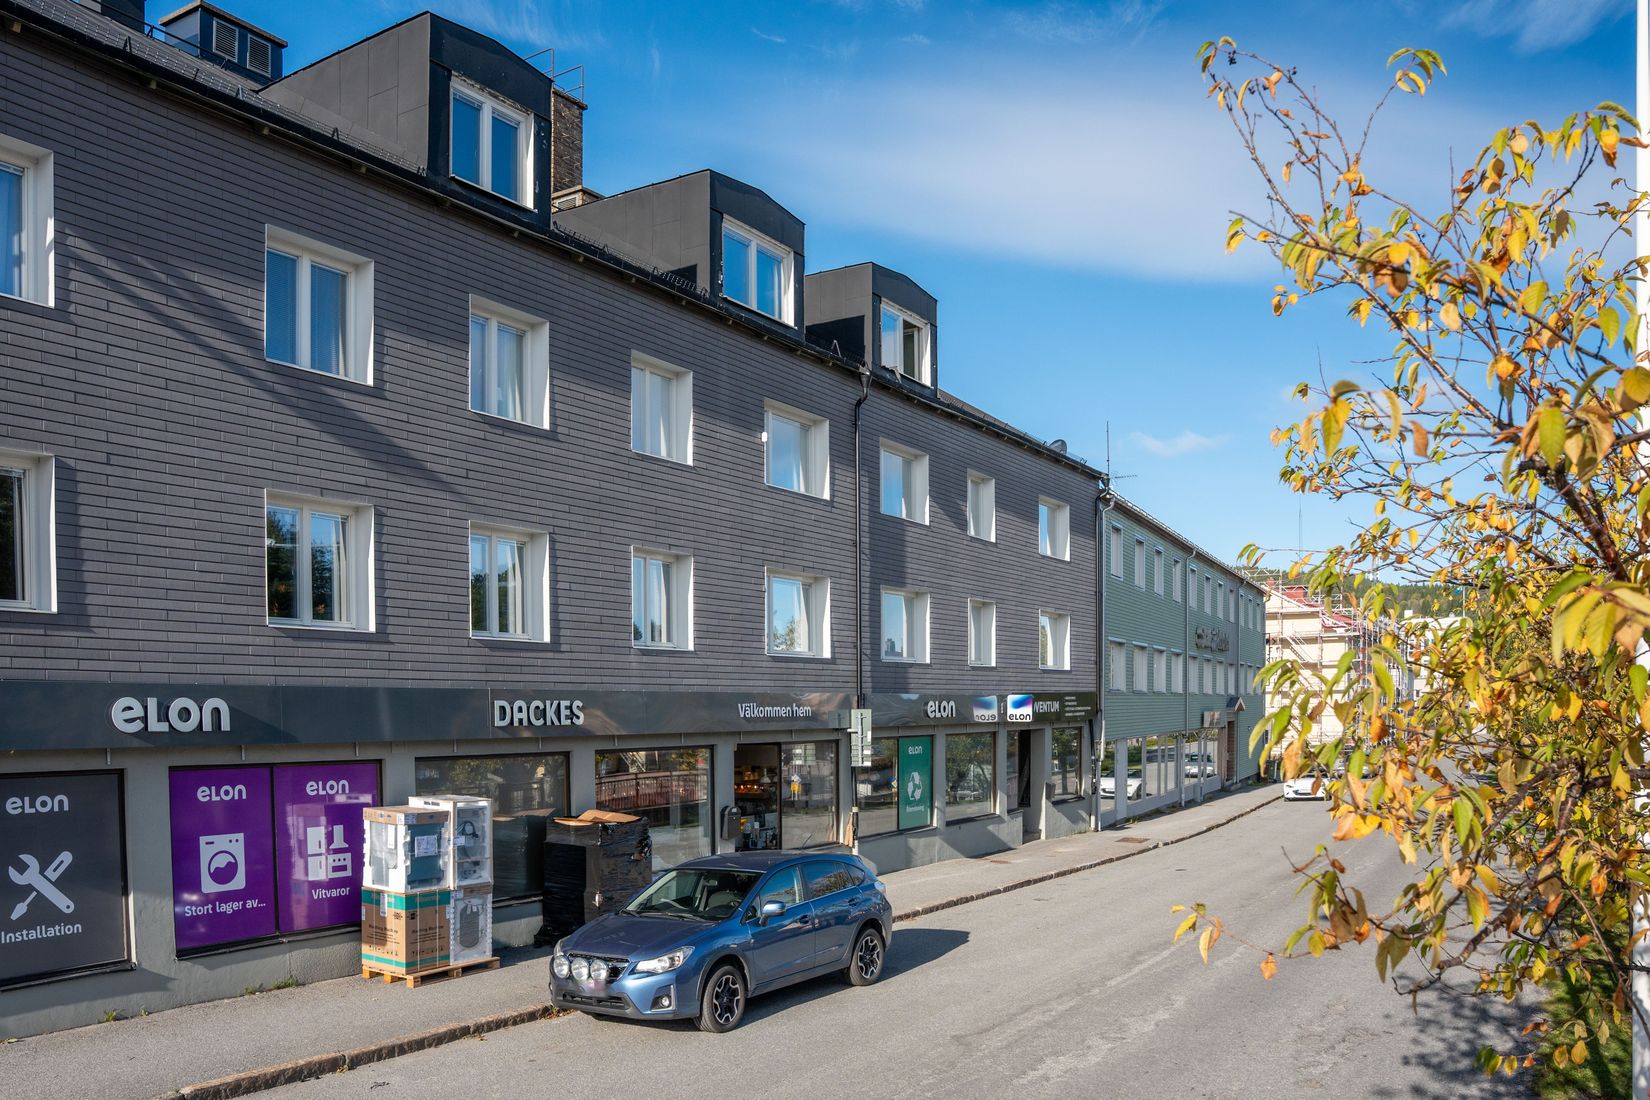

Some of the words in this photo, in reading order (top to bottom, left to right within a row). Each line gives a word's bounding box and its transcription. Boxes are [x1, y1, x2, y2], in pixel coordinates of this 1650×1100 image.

[494, 699, 584, 727] DACKES
[738, 702, 792, 718] Välkommen
[793, 703, 813, 717] hem
[312, 886, 350, 899] Vitvaror
[184, 904, 212, 916] Stort
[216, 901, 243, 914] lager
[245, 898, 266, 909] av...
[0, 922, 82, 944] Installation
